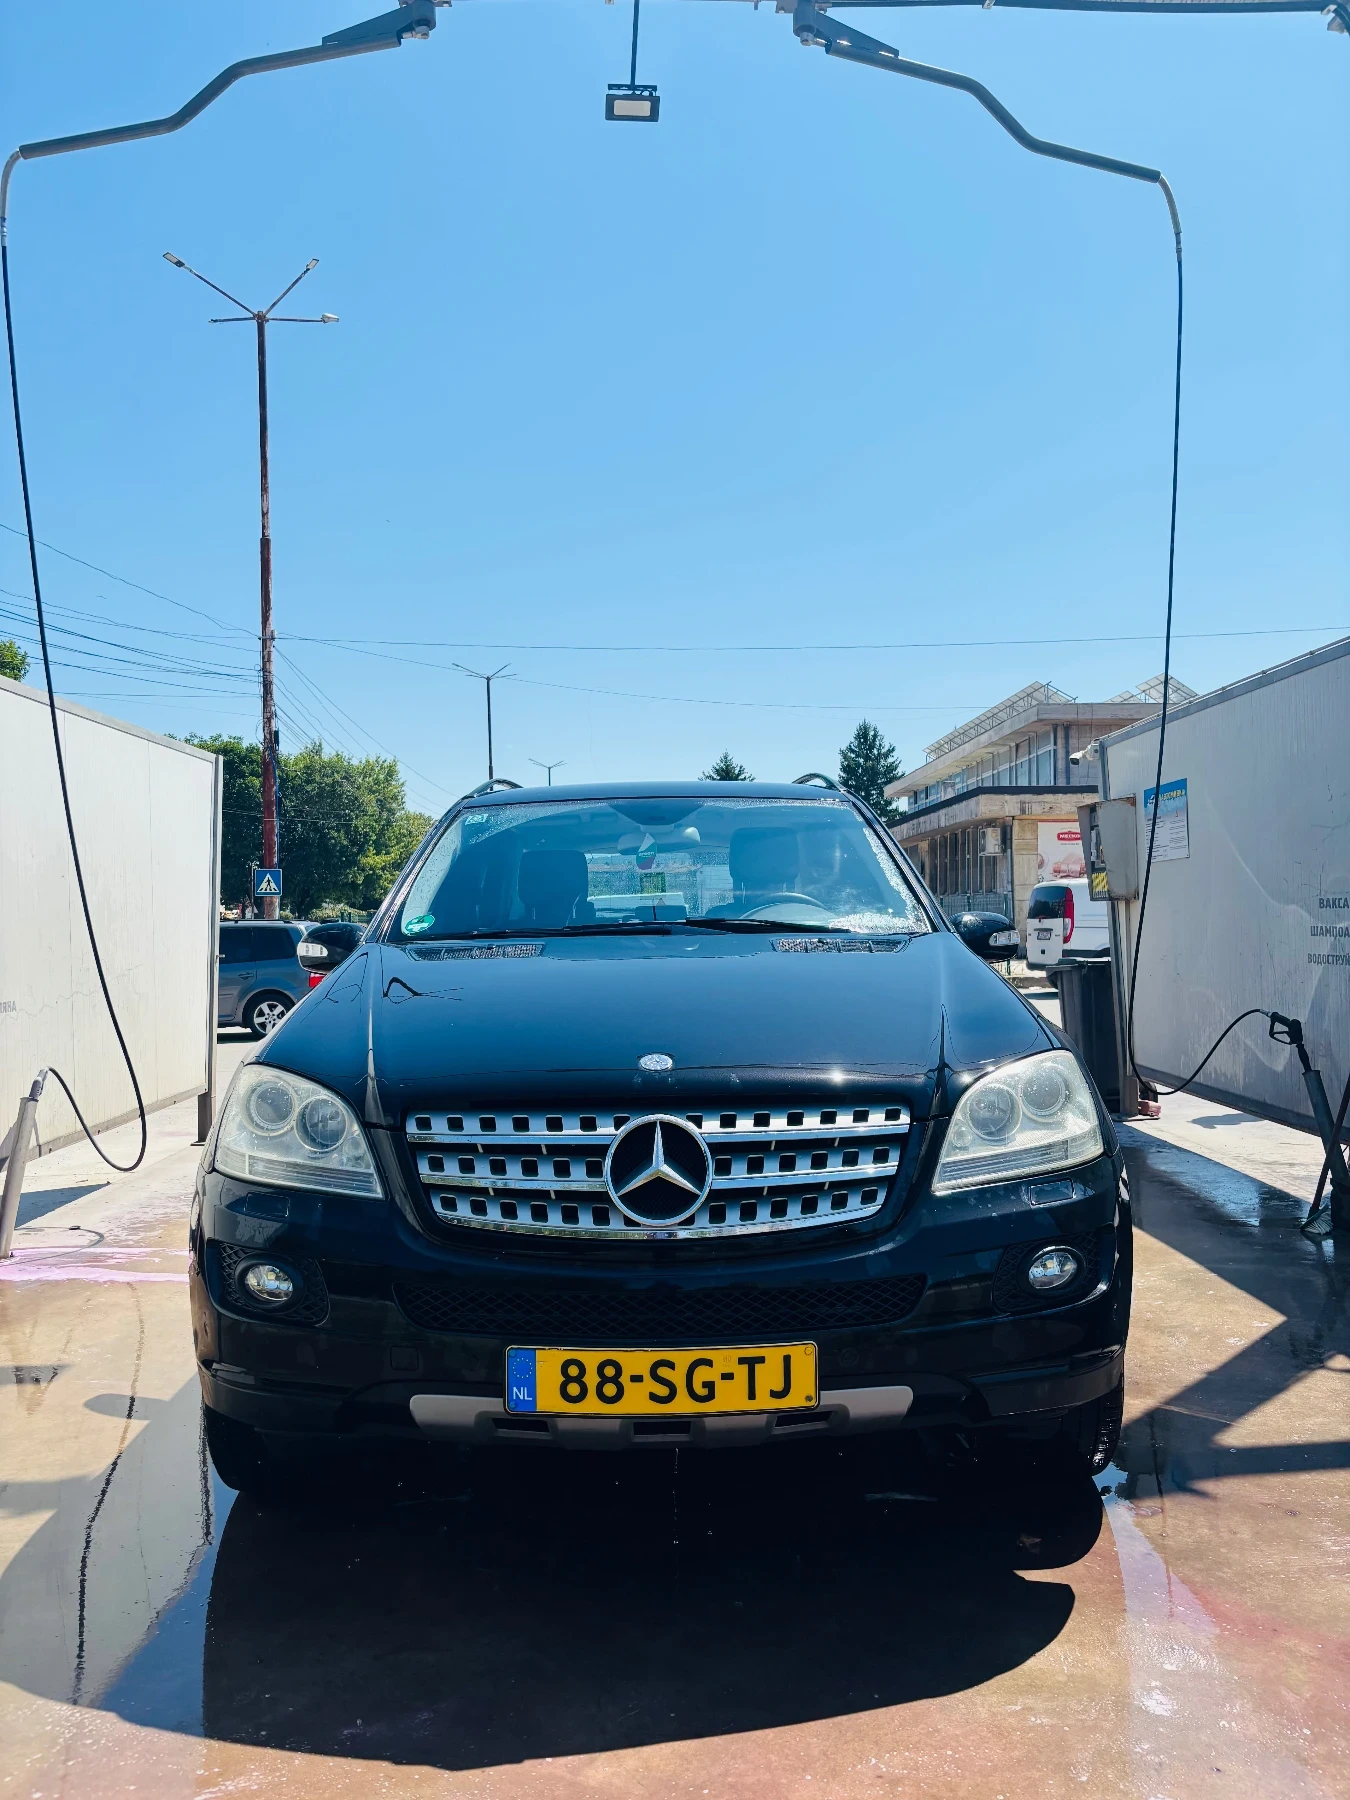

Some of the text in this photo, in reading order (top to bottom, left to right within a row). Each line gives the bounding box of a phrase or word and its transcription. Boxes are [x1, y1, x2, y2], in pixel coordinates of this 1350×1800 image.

[1318, 897, 1350, 909] ВАКСА
[559, 1354, 792, 1404] 88-SG-TJ
[512, 1386, 533, 1401] NL
